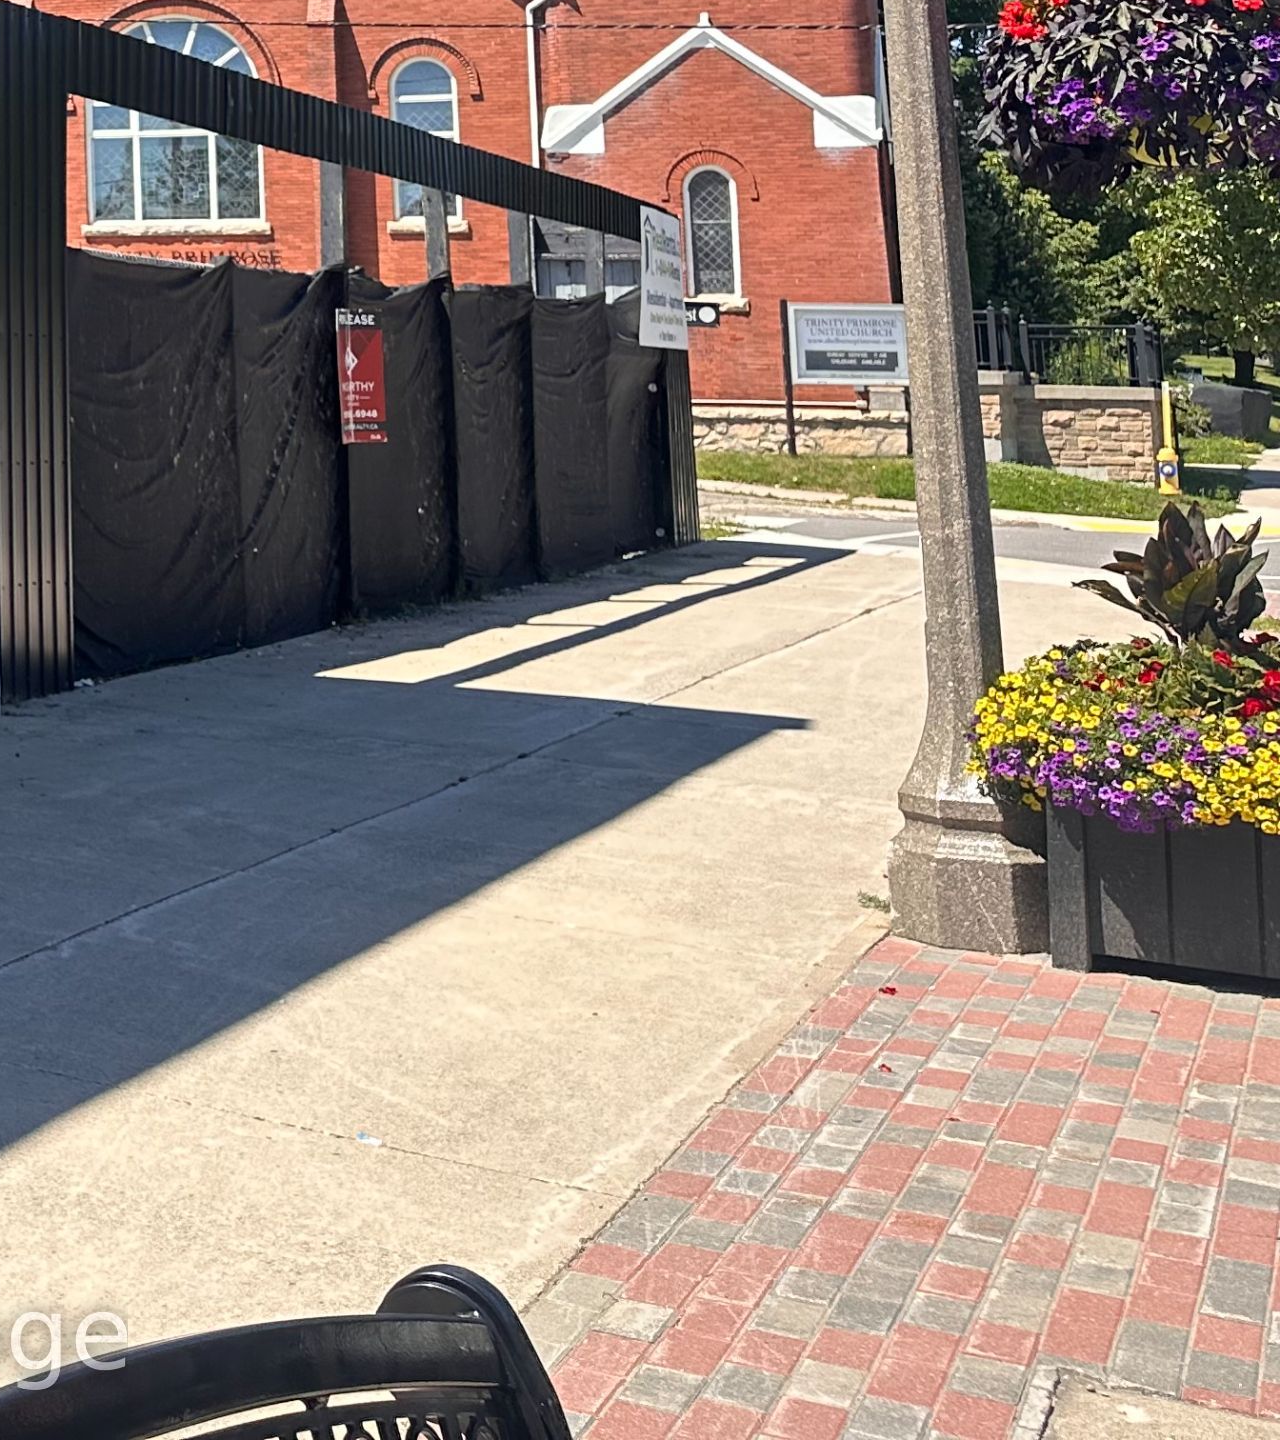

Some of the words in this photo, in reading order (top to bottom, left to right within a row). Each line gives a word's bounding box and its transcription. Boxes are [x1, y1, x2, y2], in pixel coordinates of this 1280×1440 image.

[805, 318, 845, 327] TRINITY
[847, 319, 896, 328] PRIMROSE
[810, 327, 849, 336] UNITED
[851, 328, 892, 337] CHURCH
